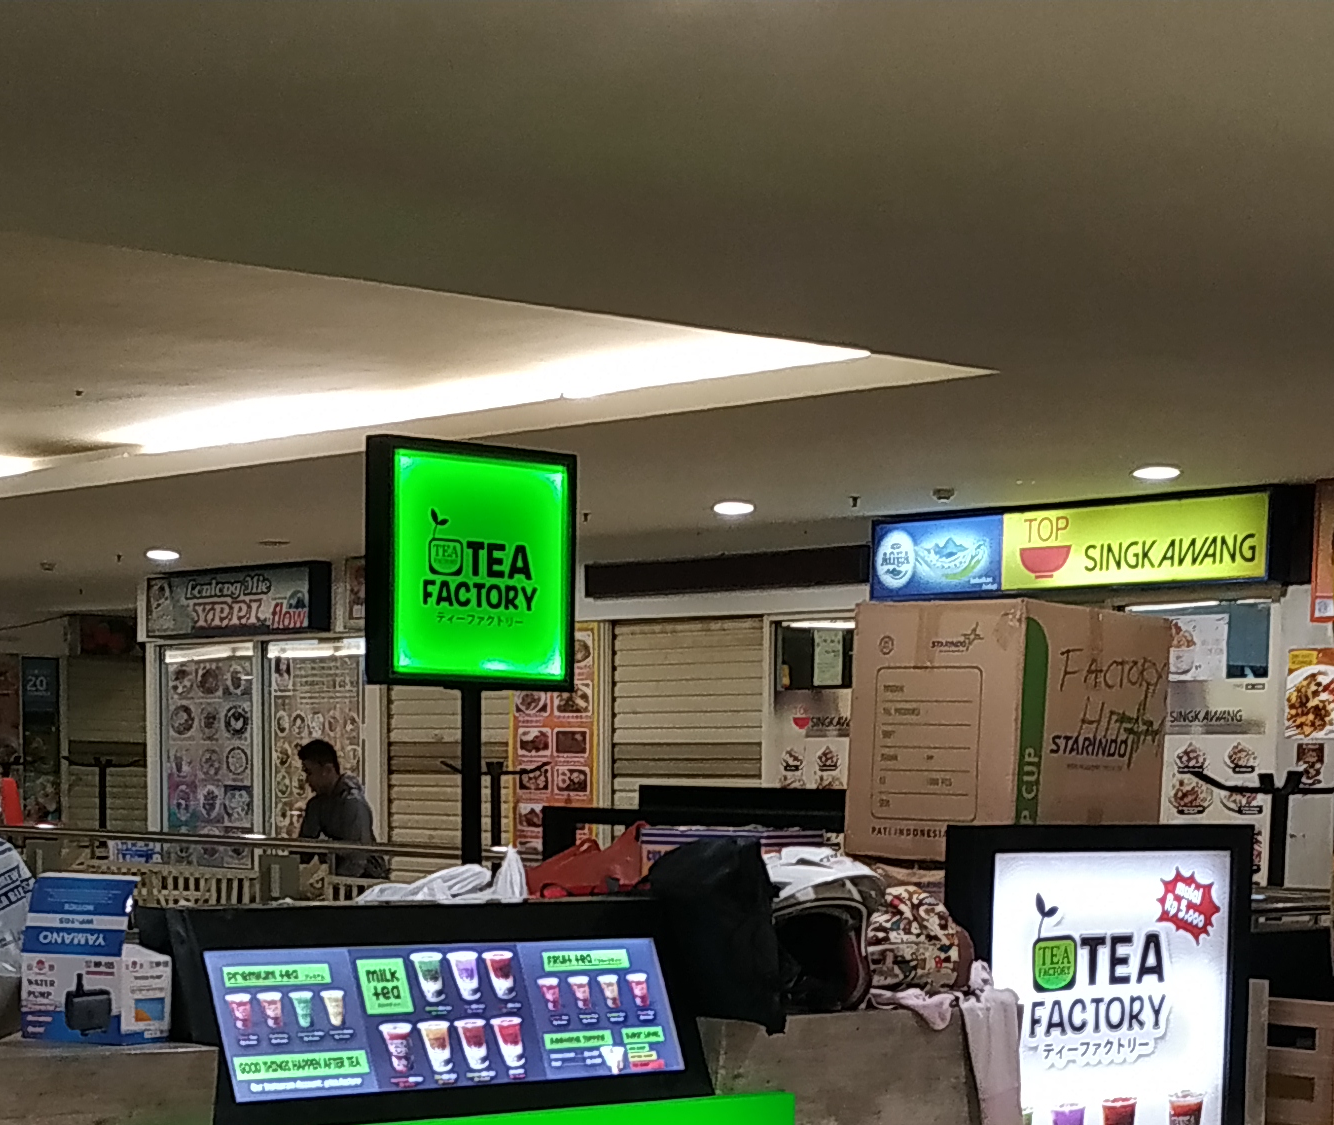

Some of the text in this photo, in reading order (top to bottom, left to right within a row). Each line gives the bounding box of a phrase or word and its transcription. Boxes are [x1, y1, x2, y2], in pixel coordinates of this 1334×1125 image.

[1023, 515, 1069, 543] TOP
[466, 540, 533, 581] TEA
[1083, 533, 1257, 572] SINGKAWANG
[422, 579, 539, 612] FACTORY
[271, 601, 307, 629] flow
[1169, 709, 1243, 723] SINGKAWANG
[1049, 735, 1129, 759] STARINDO
[1022, 747, 1040, 801] CUP
[38, 931, 106, 946] YAMANO
[1038, 945, 1071, 966] TEA
[1079, 929, 1165, 986] TEA
[1028, 993, 1167, 1039] FACTORY
[1043, 1036, 1150, 1060] ティーファクトリー
